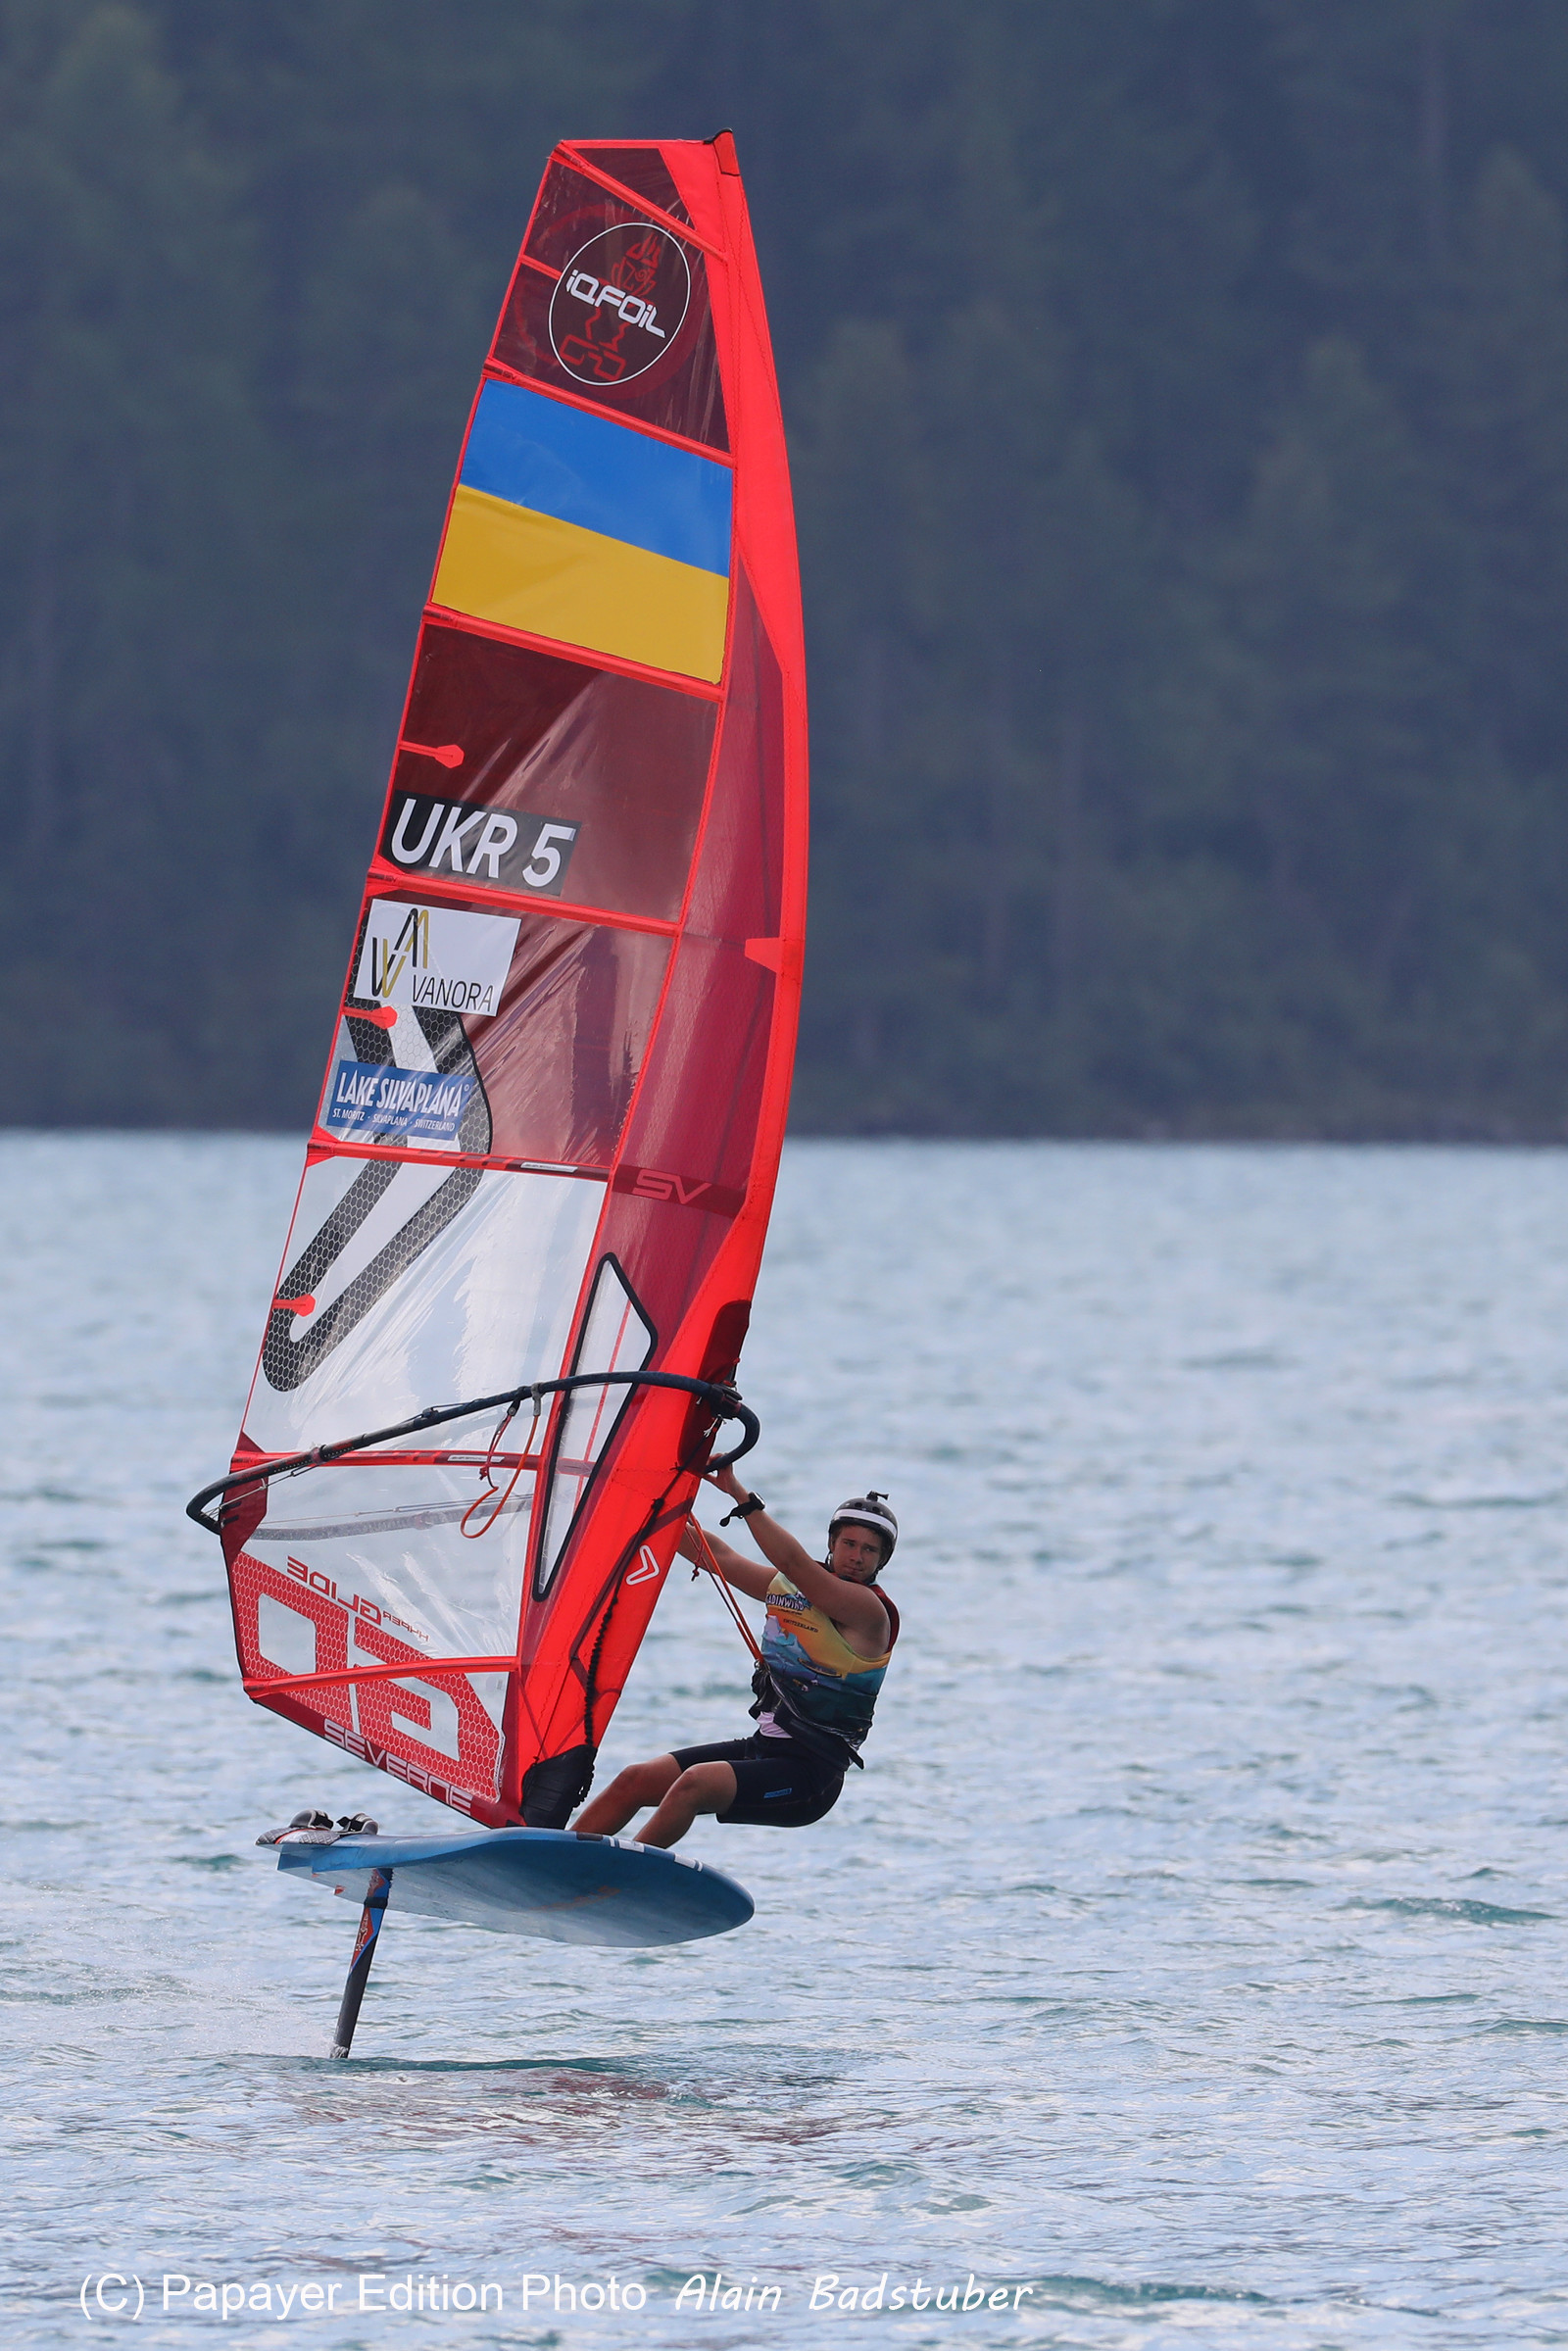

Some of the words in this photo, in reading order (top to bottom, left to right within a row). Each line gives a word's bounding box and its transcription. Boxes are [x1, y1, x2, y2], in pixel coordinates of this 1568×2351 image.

[391, 797, 518, 879] UKR
[521, 822, 577, 888] 5
[413, 973, 495, 1012] VANORA
[336, 1069, 376, 1105] LAKE
[331, 1107, 341, 1119] ST.
[342, 1108, 365, 1122] MORITZ
[372, 1114, 408, 1127] SILVAPLANA
[415, 1118, 455, 1132] SWITZERLAND
[323, 1717, 474, 1817] SEVERNE
